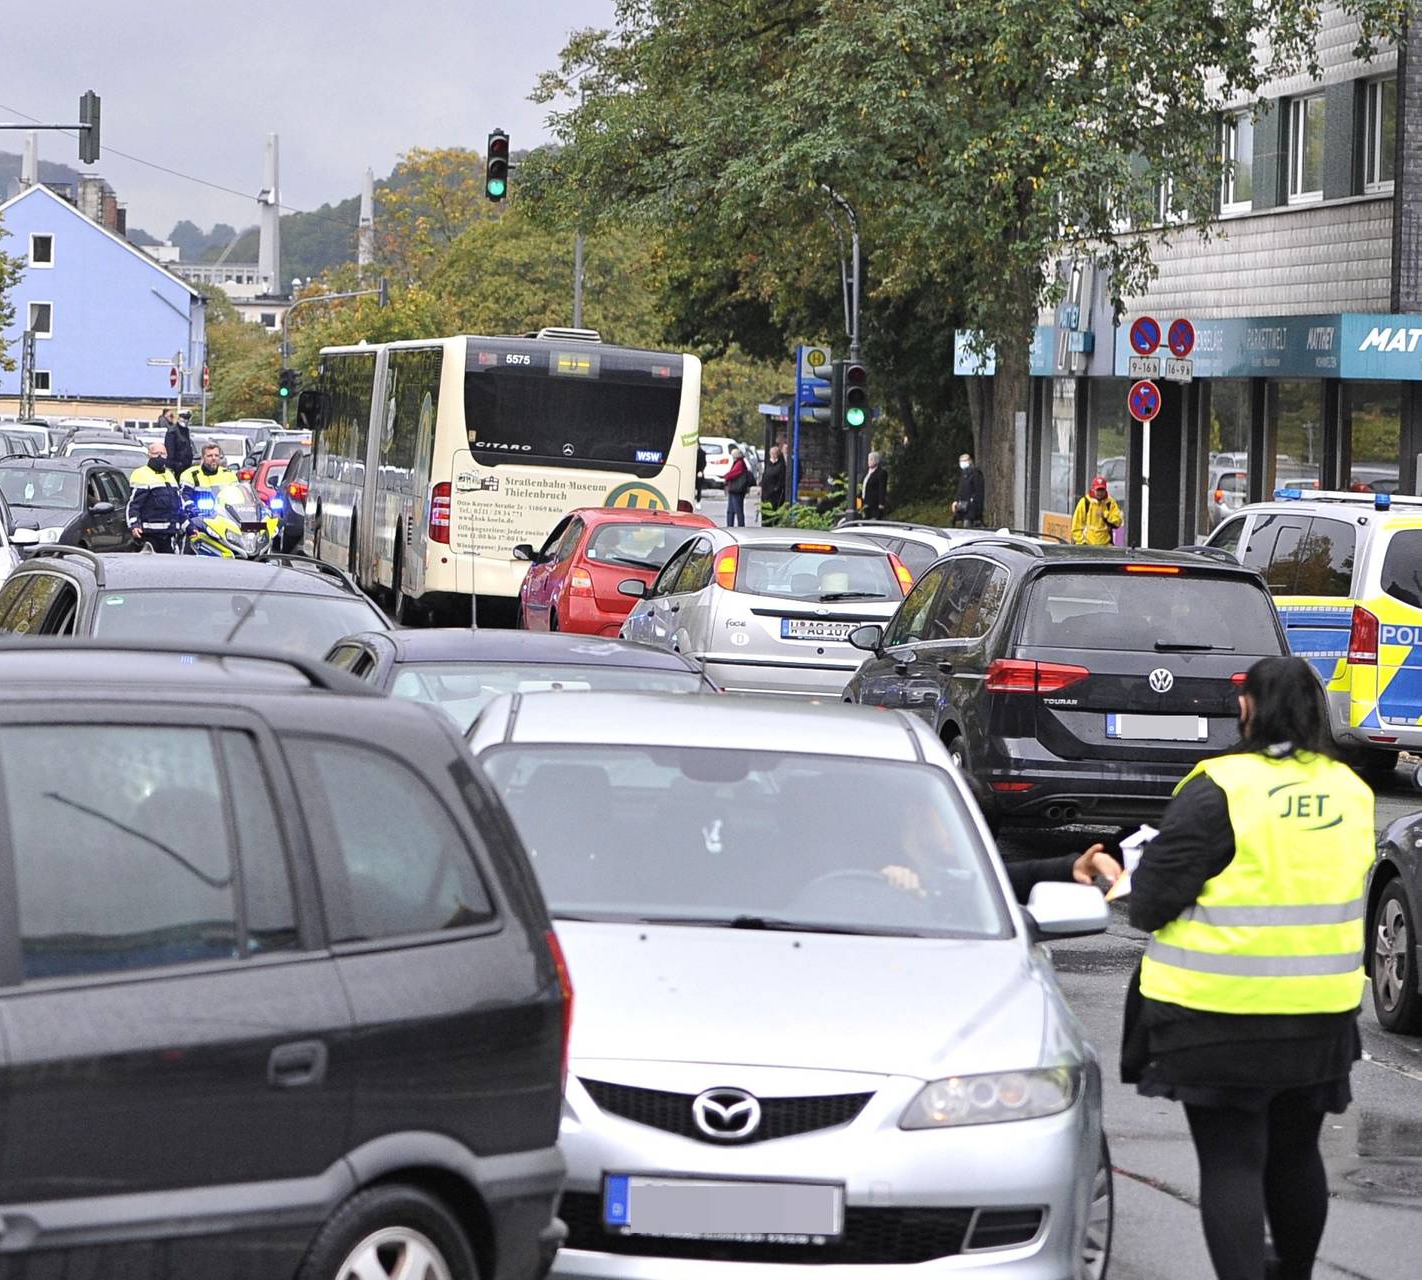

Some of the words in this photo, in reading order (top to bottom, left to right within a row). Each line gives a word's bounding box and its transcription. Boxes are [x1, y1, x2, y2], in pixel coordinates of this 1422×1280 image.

[475, 441, 532, 451] CITARO
[636, 451, 659, 462] WSW
[505, 488, 567, 500] Thielenbruch
[1280, 794, 1330, 818] JET
